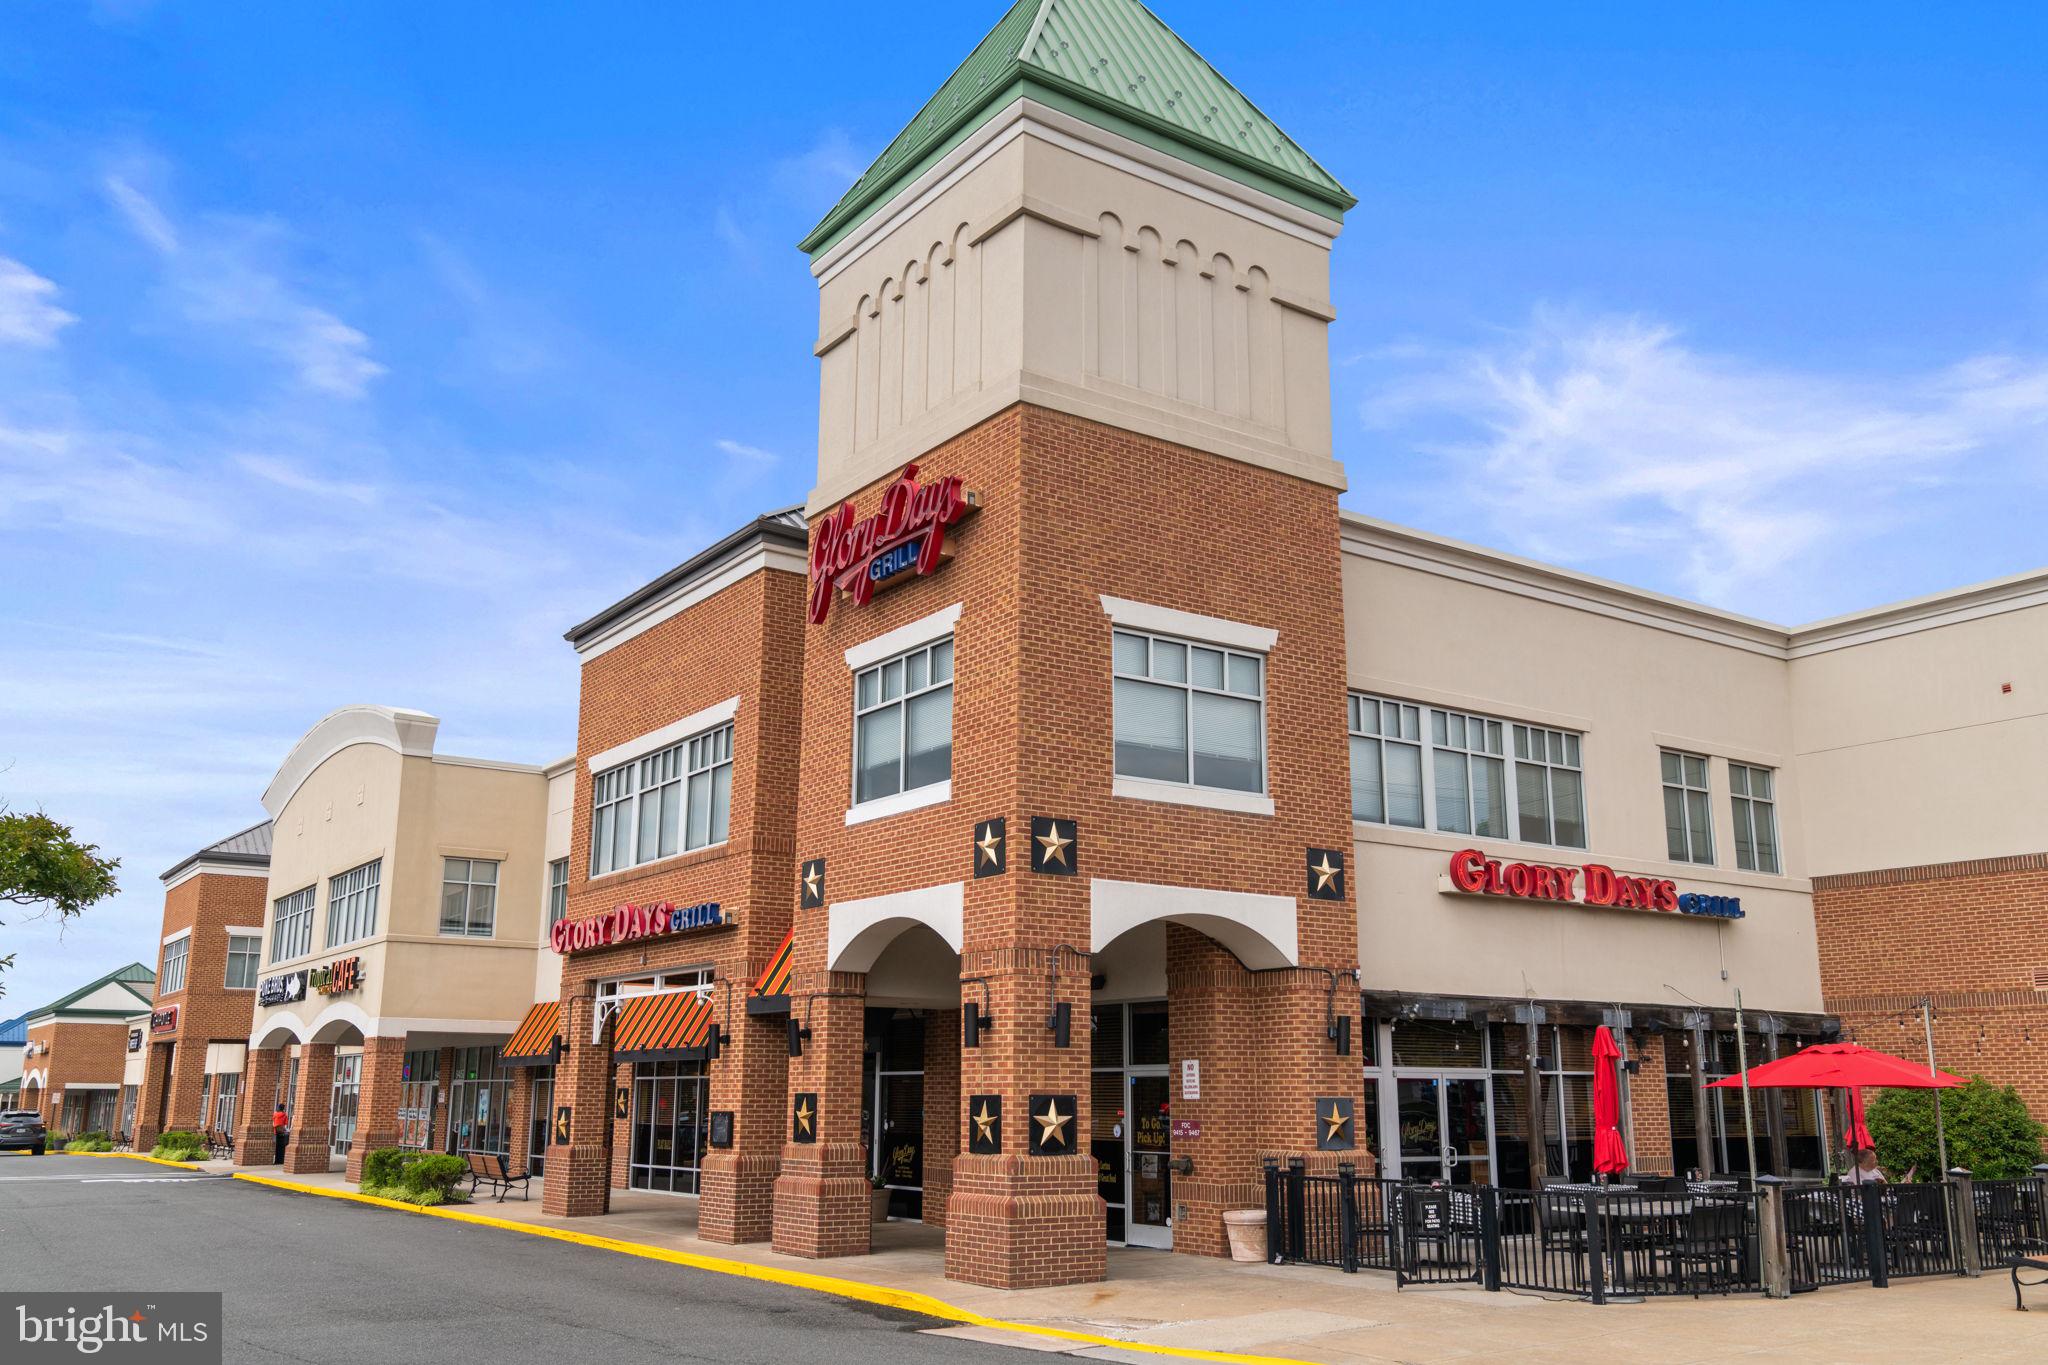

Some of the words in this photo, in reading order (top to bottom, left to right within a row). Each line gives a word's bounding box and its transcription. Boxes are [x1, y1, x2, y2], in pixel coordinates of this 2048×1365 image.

[809, 502, 886, 625] Glory
[876, 464, 968, 577] Days
[870, 542, 921, 582] GRILL
[1450, 849, 1579, 901] GLORY
[1582, 864, 1678, 912] DAYS
[551, 914, 614, 955] GLORY
[611, 901, 676, 943] DAYS
[670, 902, 723, 932] GRILL
[332, 957, 359, 994] CAFE
[1186, 1063, 1195, 1071] NO
[1137, 1131, 1151, 1144] Pick
[1141, 1117, 1149, 1129] To
